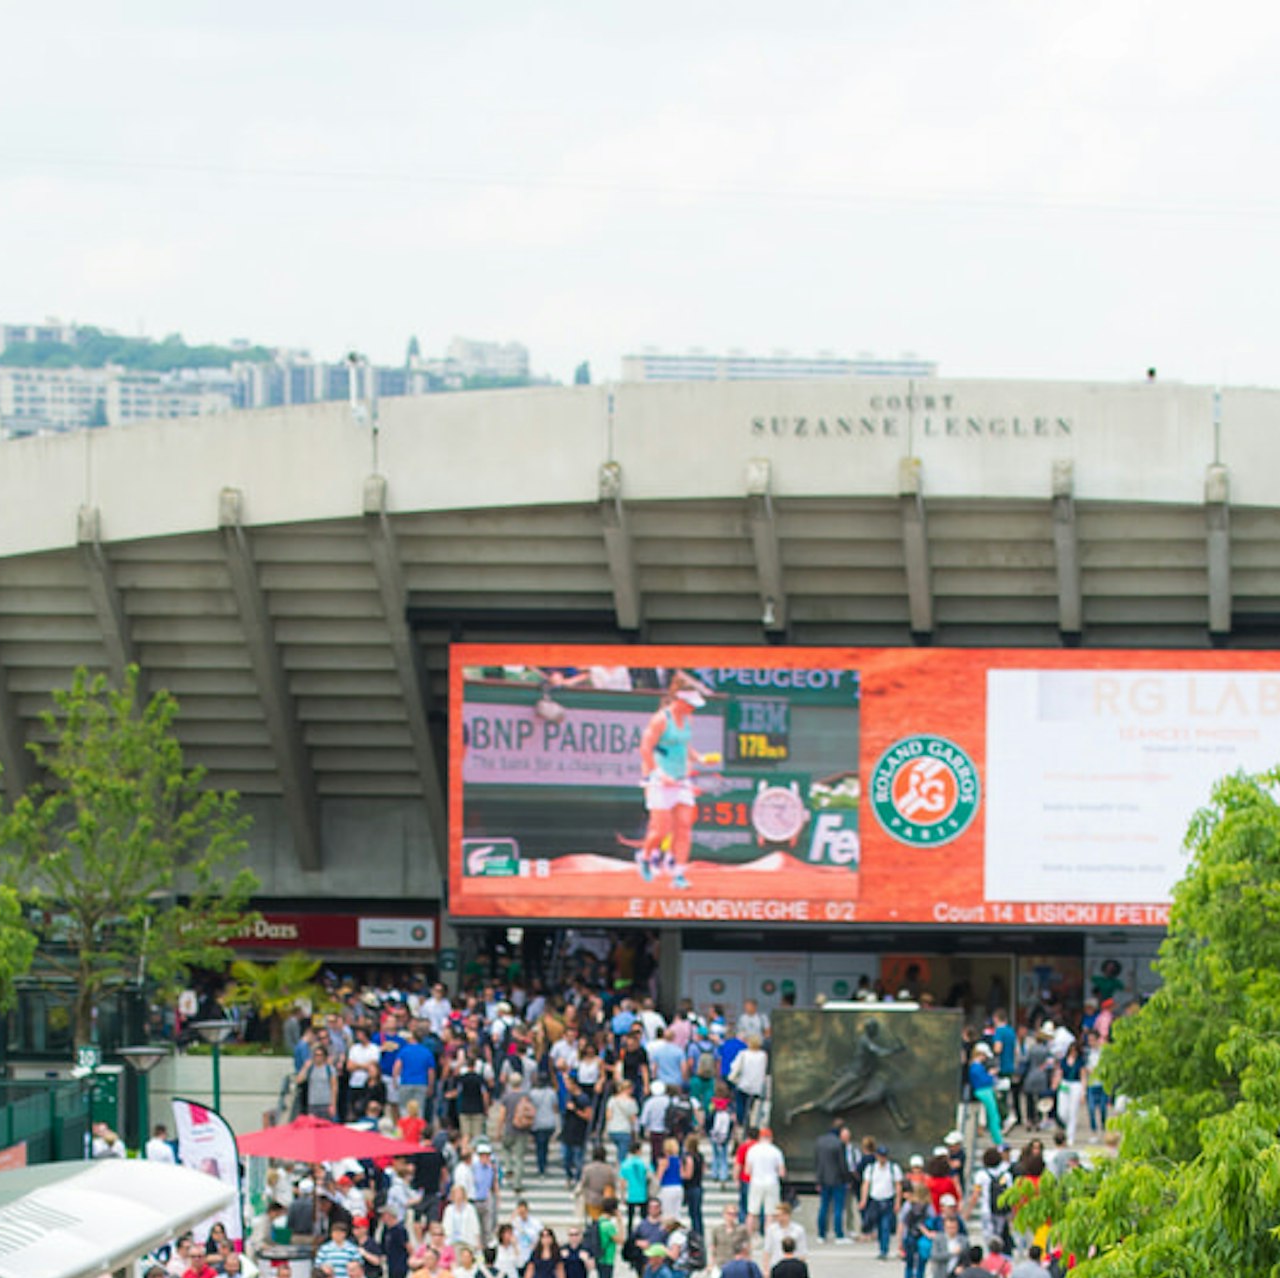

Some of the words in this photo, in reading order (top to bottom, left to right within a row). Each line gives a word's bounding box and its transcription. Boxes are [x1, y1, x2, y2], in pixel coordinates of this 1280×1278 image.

[870, 395, 954, 412] COURT
[751, 416, 899, 437] SUZANNE
[924, 416, 1073, 437] LENGLEN
[717, 668, 844, 689] PEUGEOT
[1093, 676, 1165, 717] RG
[740, 702, 789, 733] IBM
[472, 716, 533, 751] BNP
[544, 720, 642, 755] PARIBA
[874, 740, 923, 803] ROLAND
[927, 740, 975, 803] GARROS
[660, 898, 809, 920] VANDEWEGHE
[933, 902, 985, 922] Court
[991, 903, 1014, 922] 14
[1024, 902, 1097, 923] LISICKI
